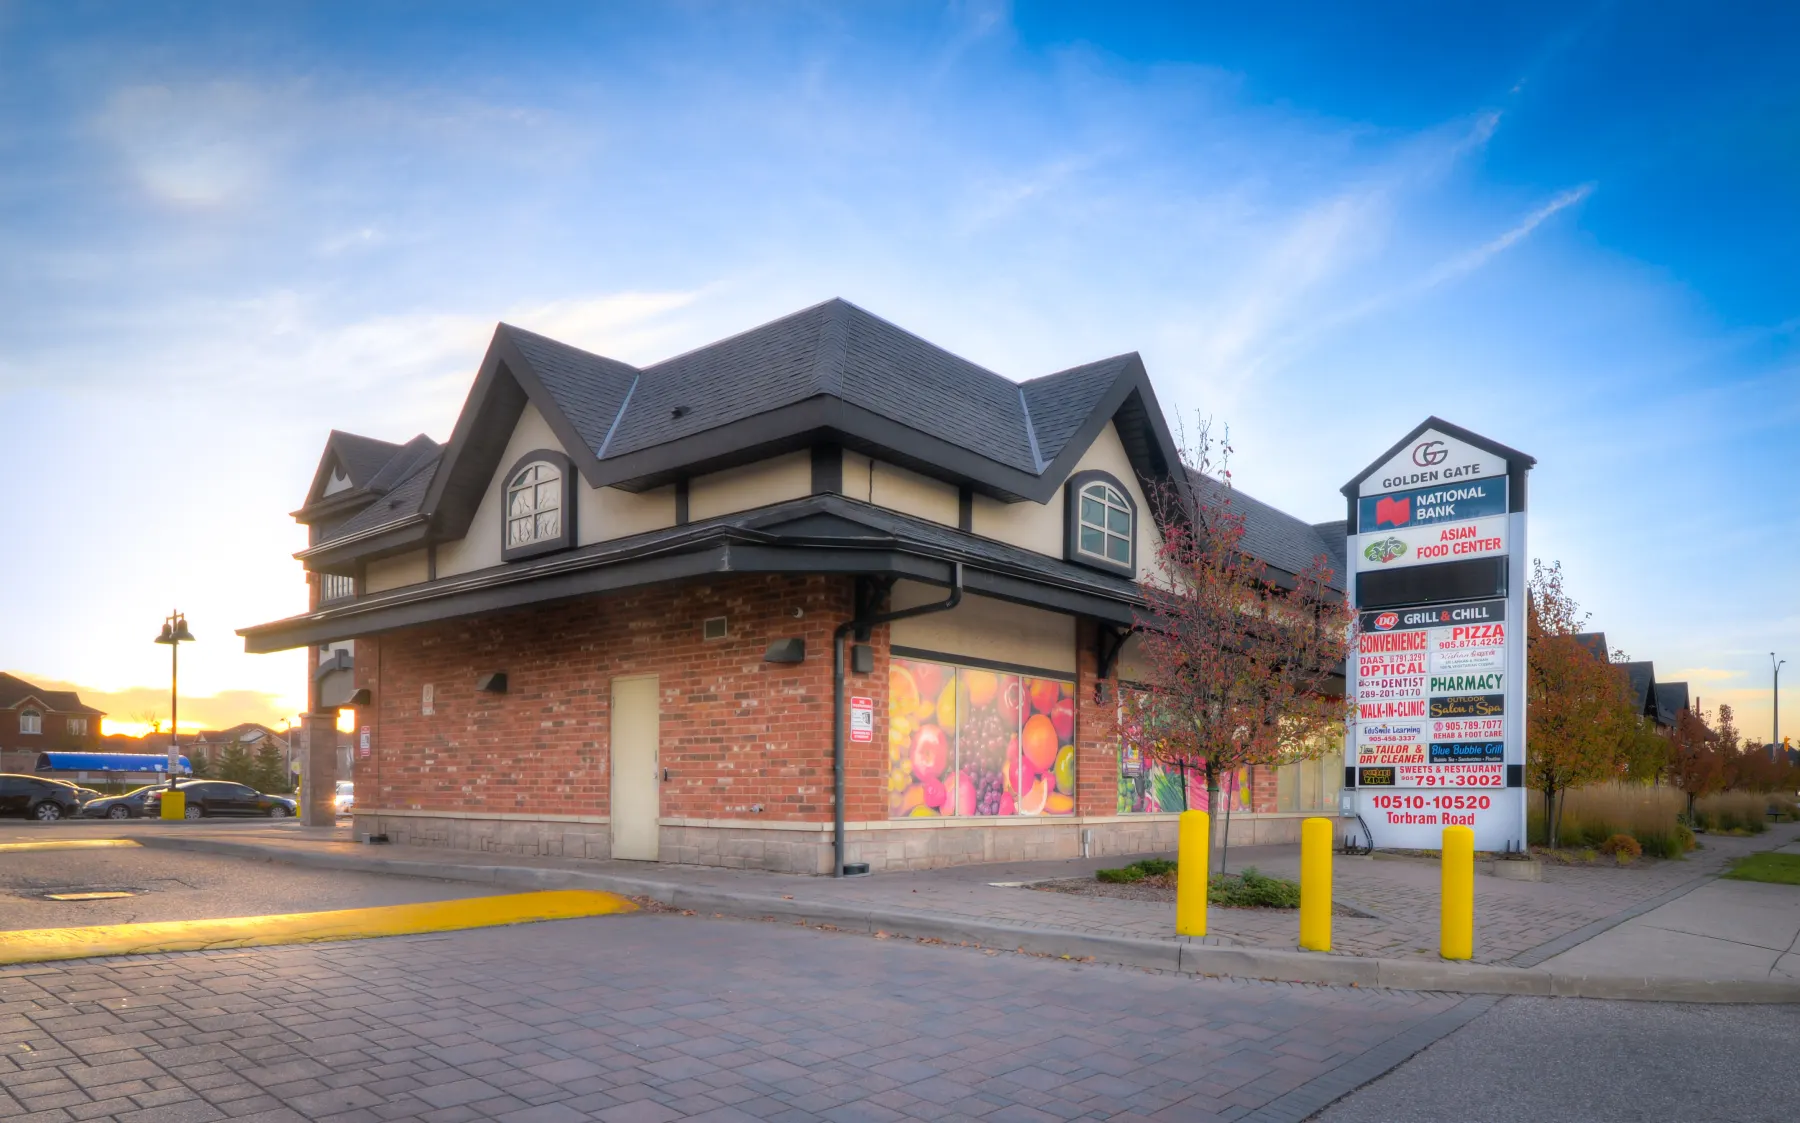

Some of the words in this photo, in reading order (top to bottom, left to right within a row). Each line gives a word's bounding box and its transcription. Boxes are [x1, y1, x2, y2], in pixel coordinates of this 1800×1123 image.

[1382, 471, 1438, 488] GOLDEN
[1443, 464, 1481, 478] GATE
[1416, 486, 1486, 506] NATIONAL
[1416, 504, 1455, 520] BANK
[1440, 526, 1477, 542] ASIAN
[1417, 544, 1448, 559] FOOD
[1453, 538, 1502, 555] CENTER
[1380, 616, 1396, 626] DQ
[1404, 612, 1439, 624] GRILL
[1440, 610, 1450, 621] &
[1452, 607, 1490, 620] CHILL
[1453, 624, 1504, 640] PIZZA
[1360, 632, 1426, 653] CONVENIENCE
[1439, 638, 1504, 649] 905.874.4242
[1360, 656, 1384, 664] DAAS
[1396, 653, 1426, 662] 791.3291
[1360, 662, 1426, 677] OPTICAL
[1382, 677, 1424, 688] DENTIST
[1430, 674, 1504, 692] PHARMACY
[1360, 688, 1421, 698] 289-201-0170
[1360, 701, 1425, 719] WALK-IN-CLINIC
[1431, 703, 1467, 716] Salon
[1476, 702, 1503, 715] Spa
[1392, 726, 1420, 734] Learning
[1446, 720, 1502, 730] 905.789.7077
[1376, 744, 1409, 754] TAILOR
[1415, 744, 1423, 754] &
[1431, 744, 1450, 756] Blue
[1453, 744, 1482, 755] Bubble
[1485, 743, 1503, 754] Grill
[1360, 755, 1378, 764] DRY
[1381, 754, 1424, 764] CLEANER
[1400, 766, 1433, 774] SWEETS
[1436, 765, 1441, 773] &
[1445, 765, 1502, 773] RESTAURANT
[1415, 775, 1502, 786] 791-3002
[1372, 795, 1491, 809] 10510-10520
[1386, 812, 1437, 825] Torbram
[1442, 813, 1475, 825] Road
